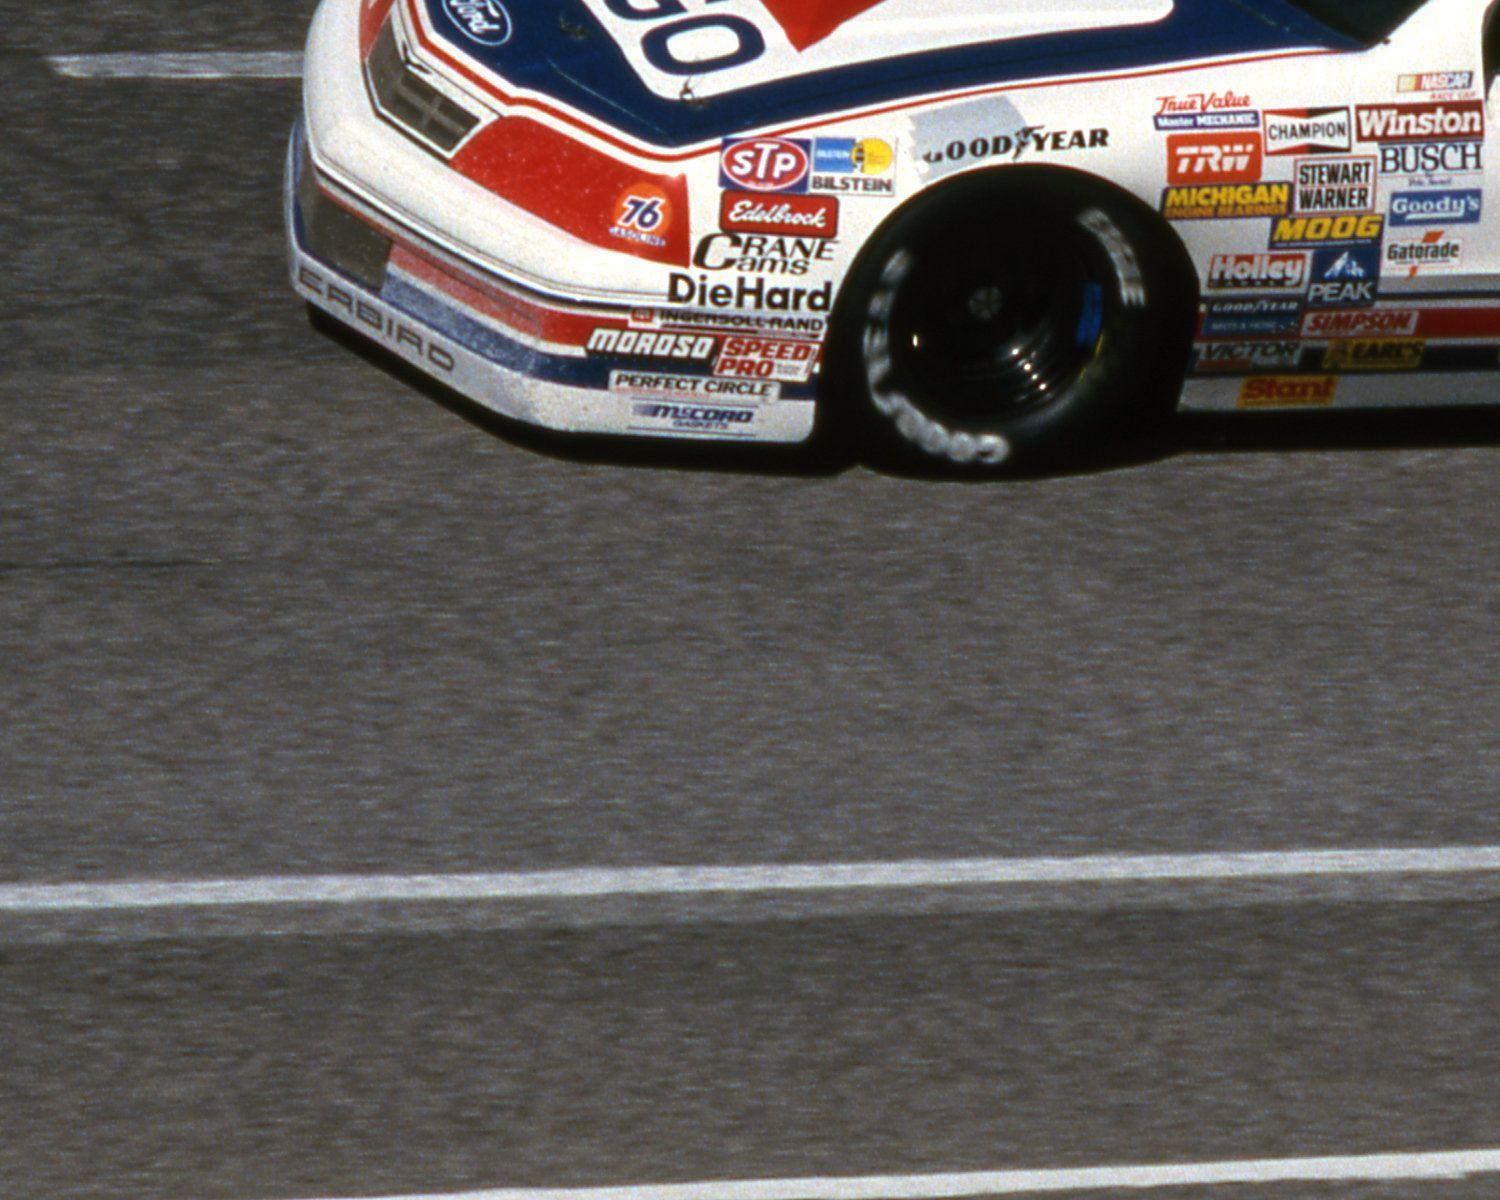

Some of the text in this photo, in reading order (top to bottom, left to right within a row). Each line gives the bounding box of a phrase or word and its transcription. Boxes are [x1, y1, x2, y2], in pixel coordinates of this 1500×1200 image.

[1421, 72, 1470, 91] NASCAR
[1155, 90, 1251, 116] True Value
[1196, 113, 1256, 126] MECHANIC
[1268, 117, 1347, 141] CHAMPION
[1356, 107, 1481, 137] Winston
[731, 143, 797, 180] STP
[1175, 143, 1254, 173] TRW
[1379, 143, 1483, 174] BUSCH
[811, 175, 893, 192] BILSTEIN
[1299, 161, 1371, 186] STEWART
[1166, 184, 1290, 207] MICHIGAN
[1299, 187, 1368, 210] WARNER
[1391, 195, 1480, 220] Goody's
[617, 196, 666, 232] 76
[728, 200, 827, 228] Edelbrock
[1272, 215, 1383, 242] MOOG
[692, 232, 839, 270] CRANE
[1387, 241, 1460, 260] Gatorade
[1212, 255, 1303, 286] Holley
[667, 271, 833, 312] DieHard
[1307, 282, 1374, 302] PEAK
[658, 310, 824, 332] INGERSOLL-RAND
[1308, 312, 1412, 332] SIMPSON
[586, 328, 715, 359] MOROSO
[723, 337, 812, 361] SPEED
[716, 357, 775, 378] PRO
[614, 374, 700, 393] PERFECT
[703, 378, 772, 397] CIRCLE
[1246, 377, 1334, 400] Stant
[672, 419, 729, 430] GASKETS
